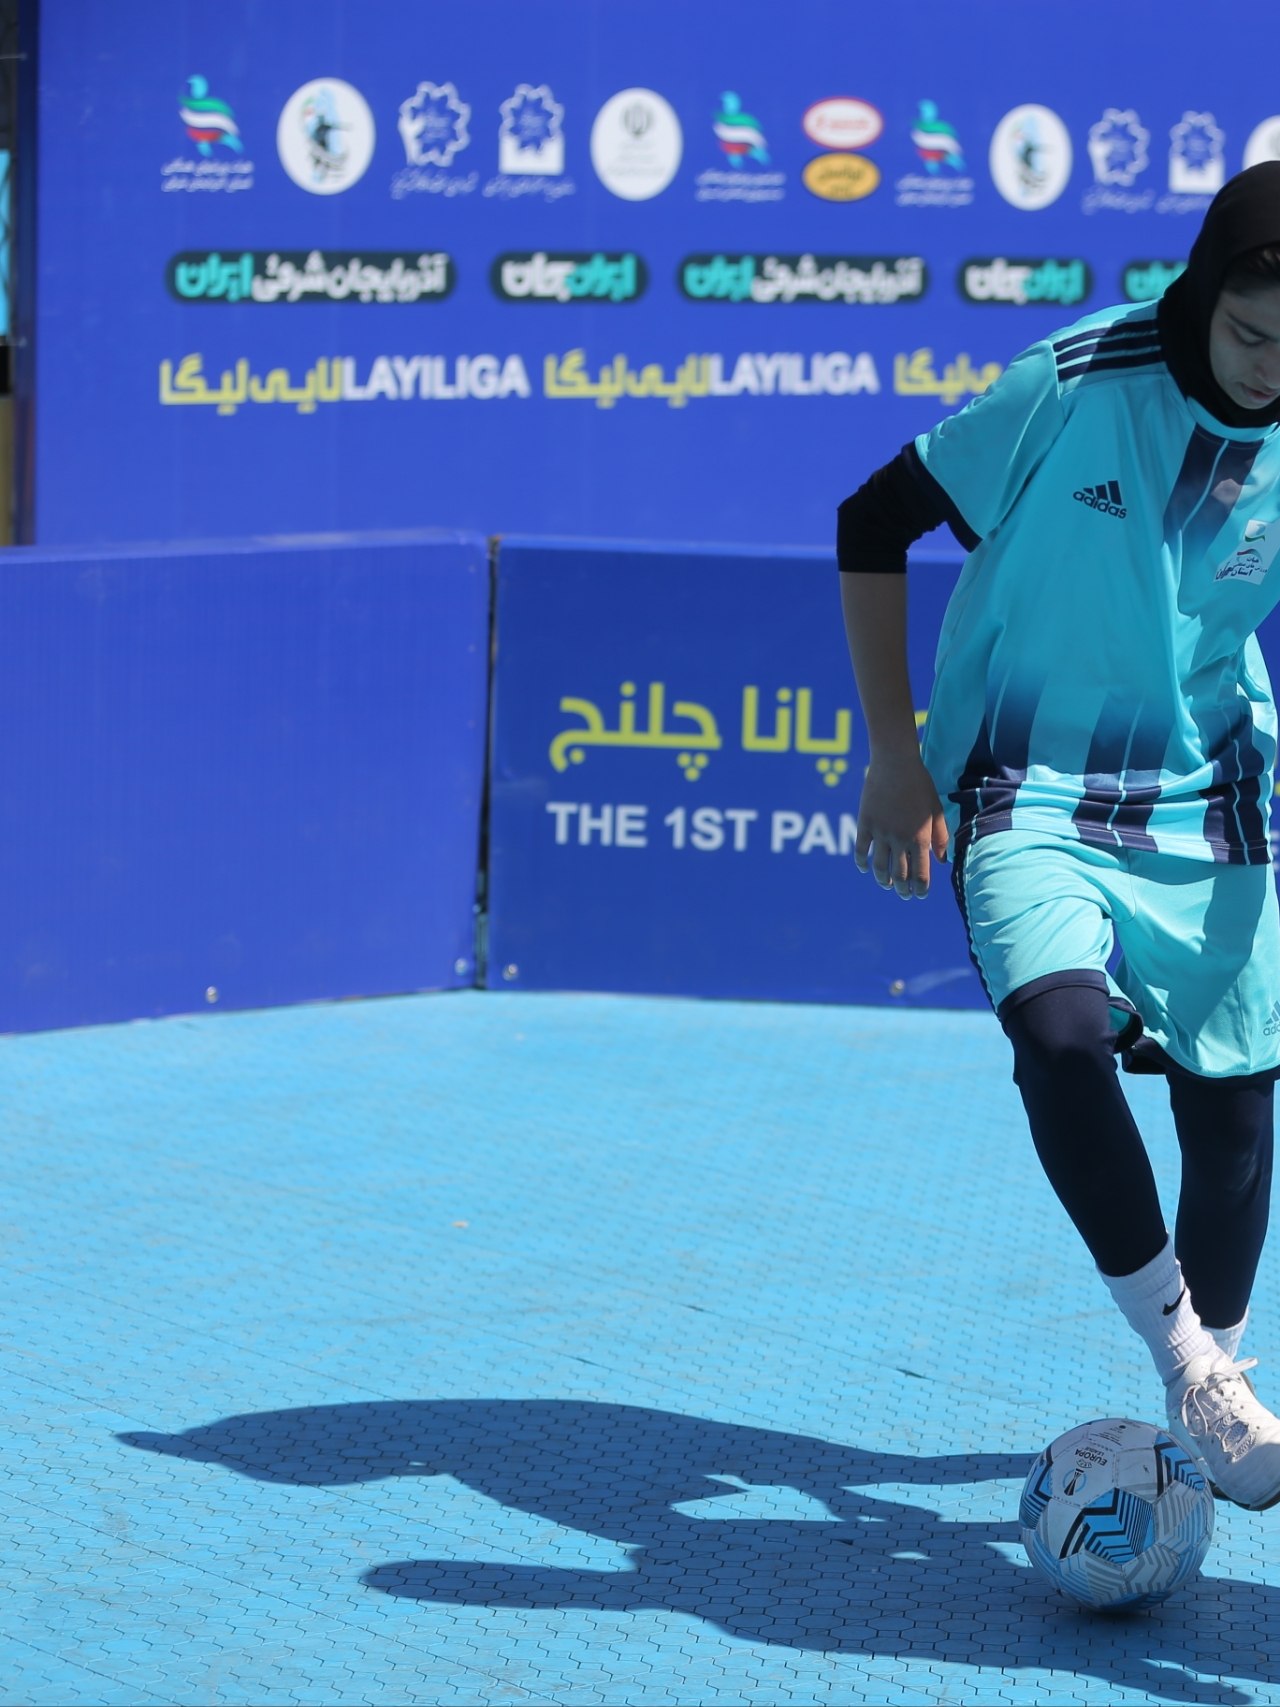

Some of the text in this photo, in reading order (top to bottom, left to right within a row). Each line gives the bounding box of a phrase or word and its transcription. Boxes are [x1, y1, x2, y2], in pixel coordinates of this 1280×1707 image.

[343, 355, 530, 401] LAYILIGA
[711, 352, 879, 396] LAYILIGA
[1073, 489, 1127, 519] adidas
[549, 681, 722, 783] چلنج
[742, 684, 851, 788] پانا
[546, 802, 648, 848] THE
[664, 807, 758, 852] 1ST
[1074, 1448, 1108, 1467] EUROPA
